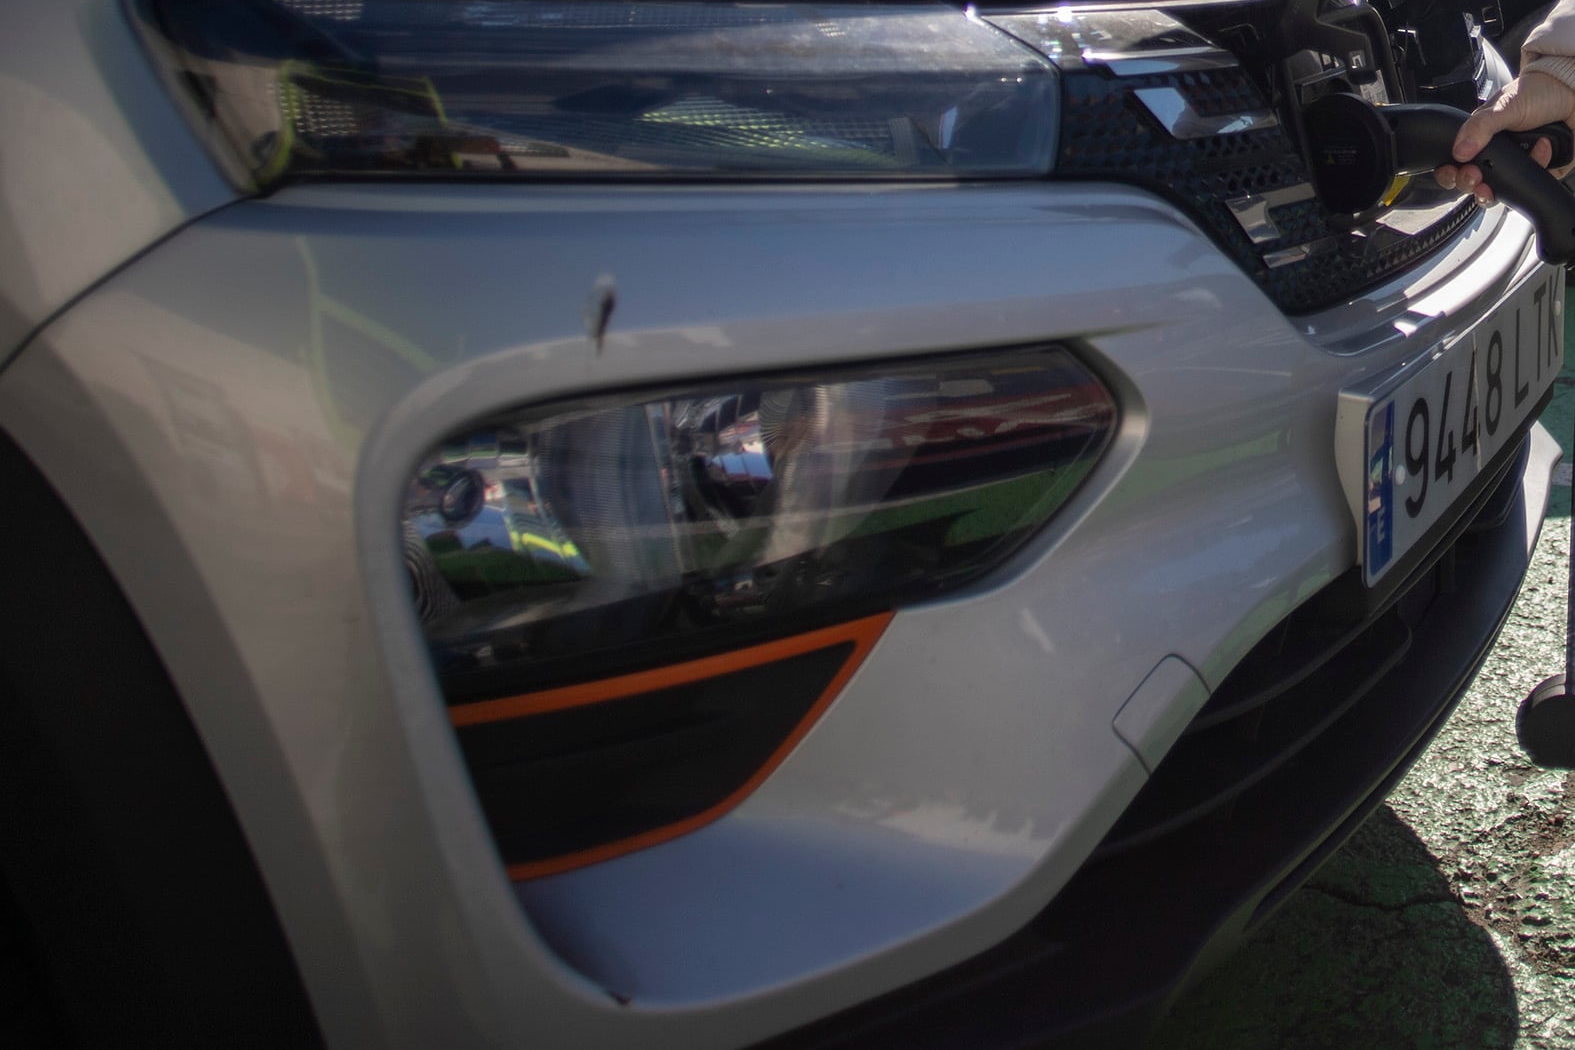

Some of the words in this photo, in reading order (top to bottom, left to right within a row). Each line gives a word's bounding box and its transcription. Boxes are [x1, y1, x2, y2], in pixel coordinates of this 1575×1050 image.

[1404, 329, 1503, 519] 9448
[1514, 266, 1559, 409] LTK
[1376, 510, 1386, 543] E
